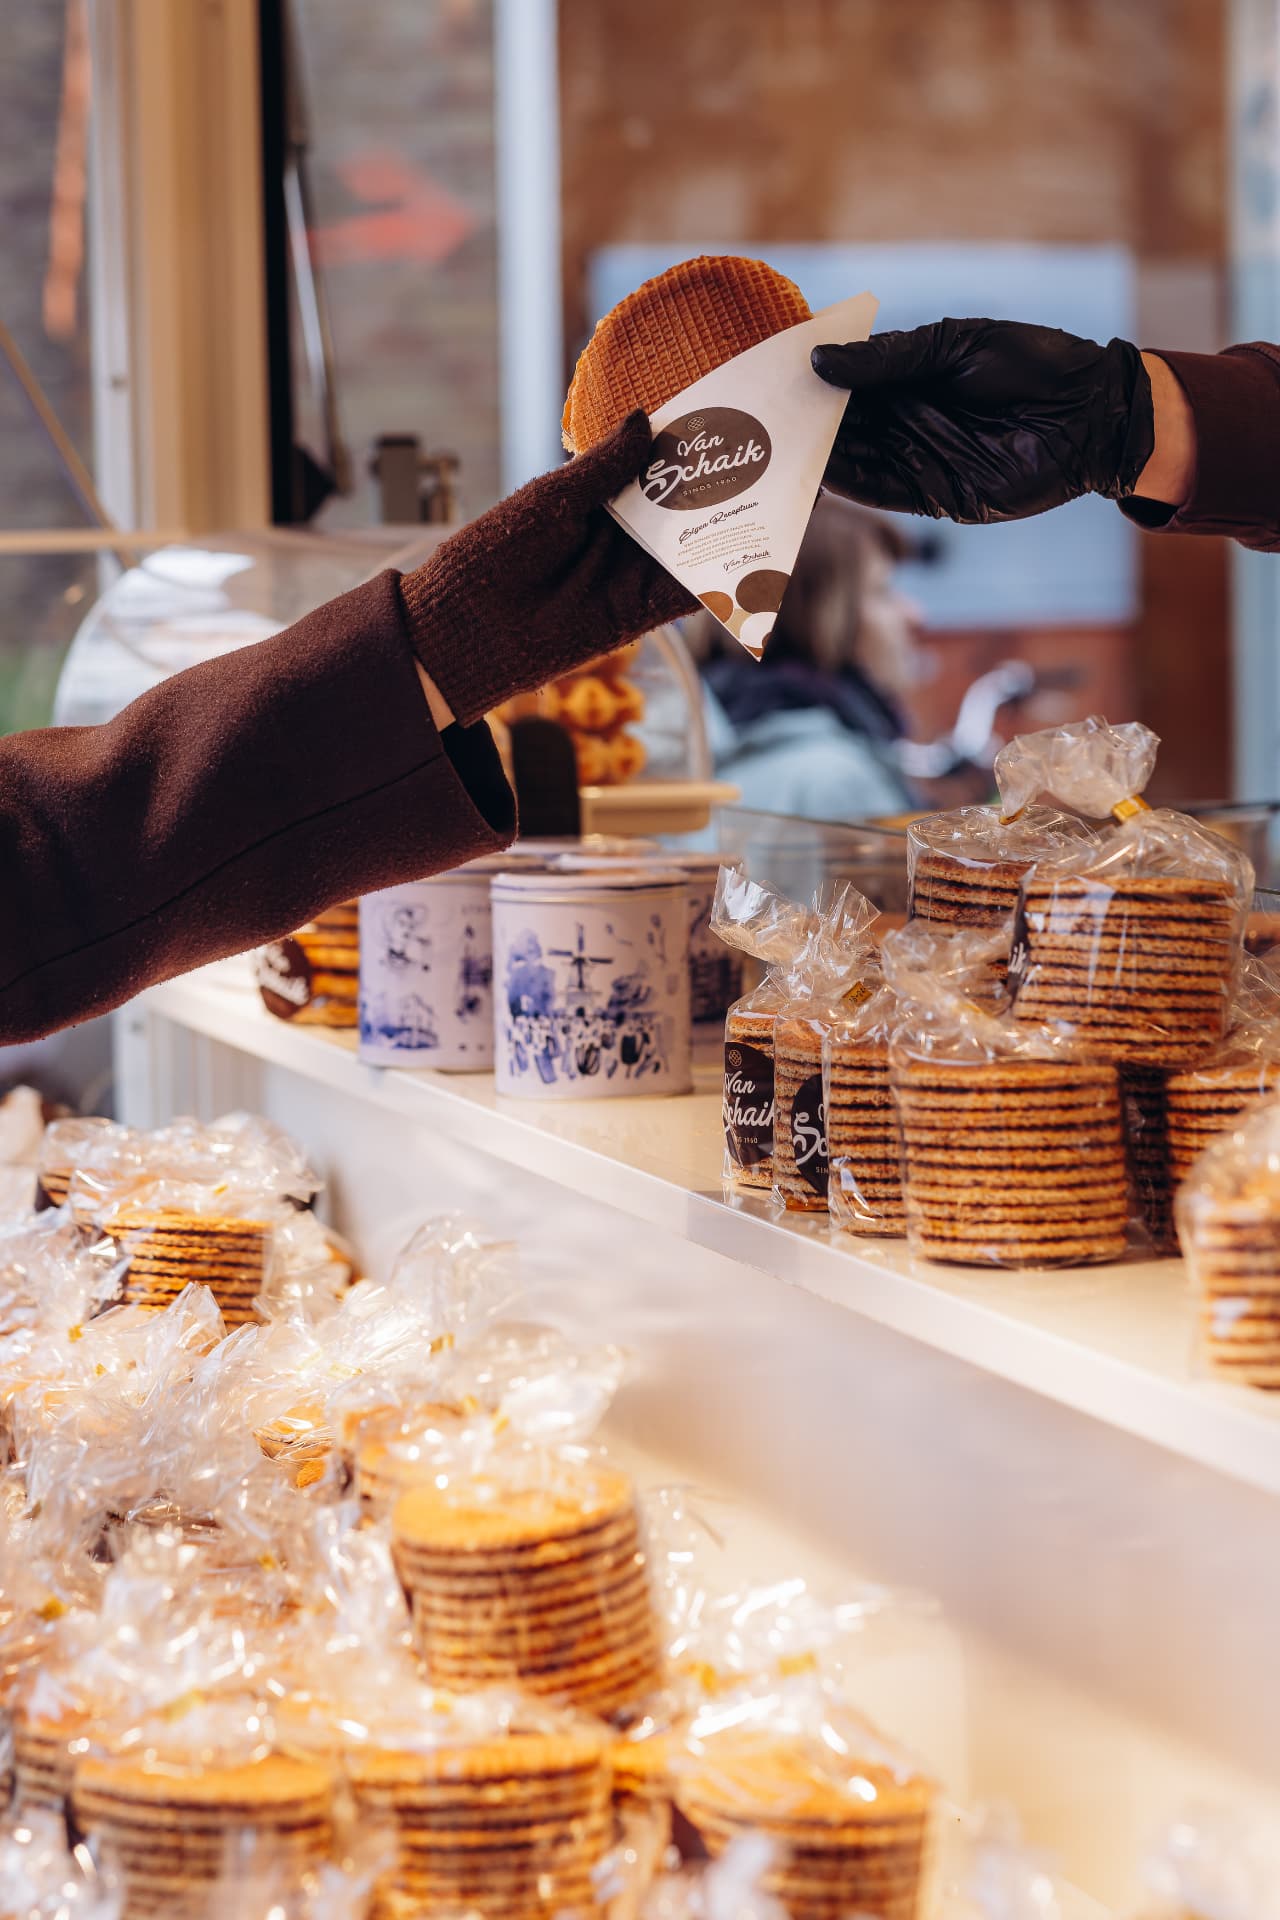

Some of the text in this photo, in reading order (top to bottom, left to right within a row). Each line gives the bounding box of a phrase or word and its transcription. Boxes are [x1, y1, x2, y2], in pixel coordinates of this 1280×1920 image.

[677, 431, 724, 456] Van
[642, 440, 766, 504] Schaik
[682, 483, 712, 497] SINDS
[678, 521, 709, 545] Eigen
[709, 501, 759, 524] Receptuur
[723, 549, 770, 572] Van Schaik
[724, 1070, 756, 1094] Van
